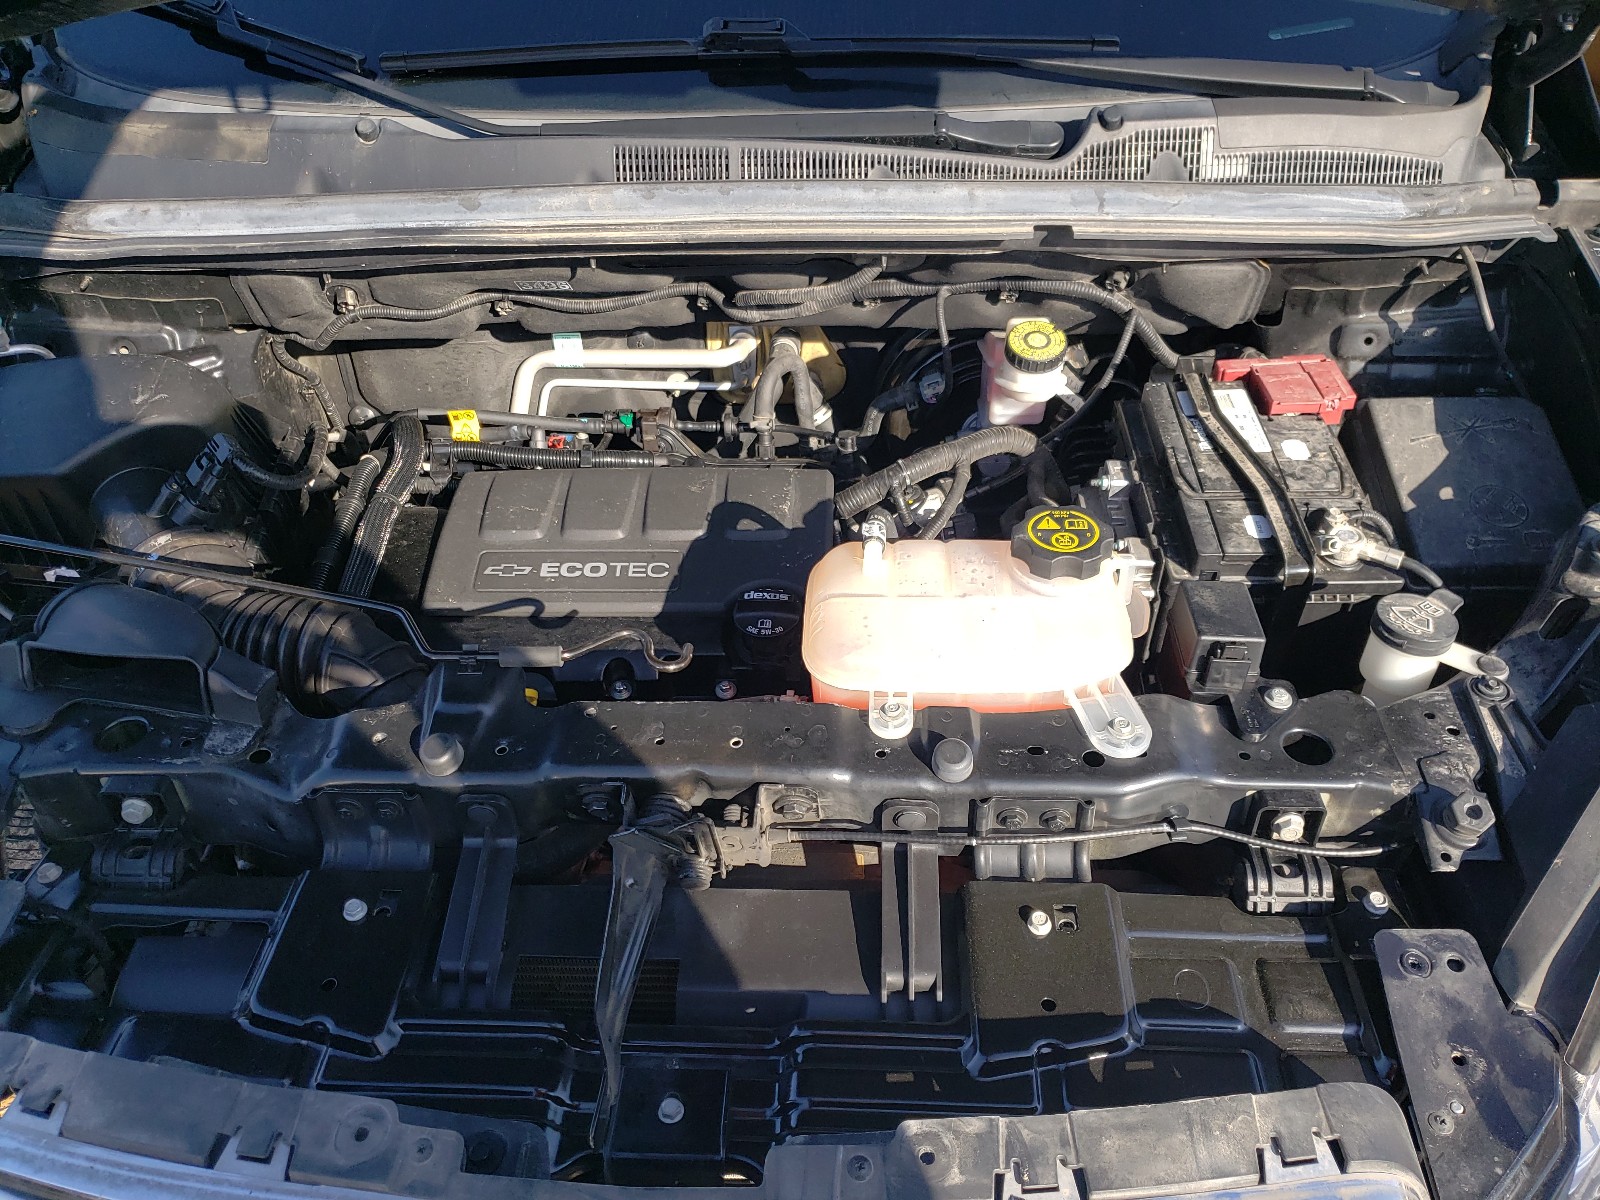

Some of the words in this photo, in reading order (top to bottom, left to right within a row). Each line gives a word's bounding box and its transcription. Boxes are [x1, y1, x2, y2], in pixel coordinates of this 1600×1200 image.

[540, 562, 670, 578] ECOTEC
[746, 625, 760, 635] SAE
[760, 626, 784, 635] 5W-30
